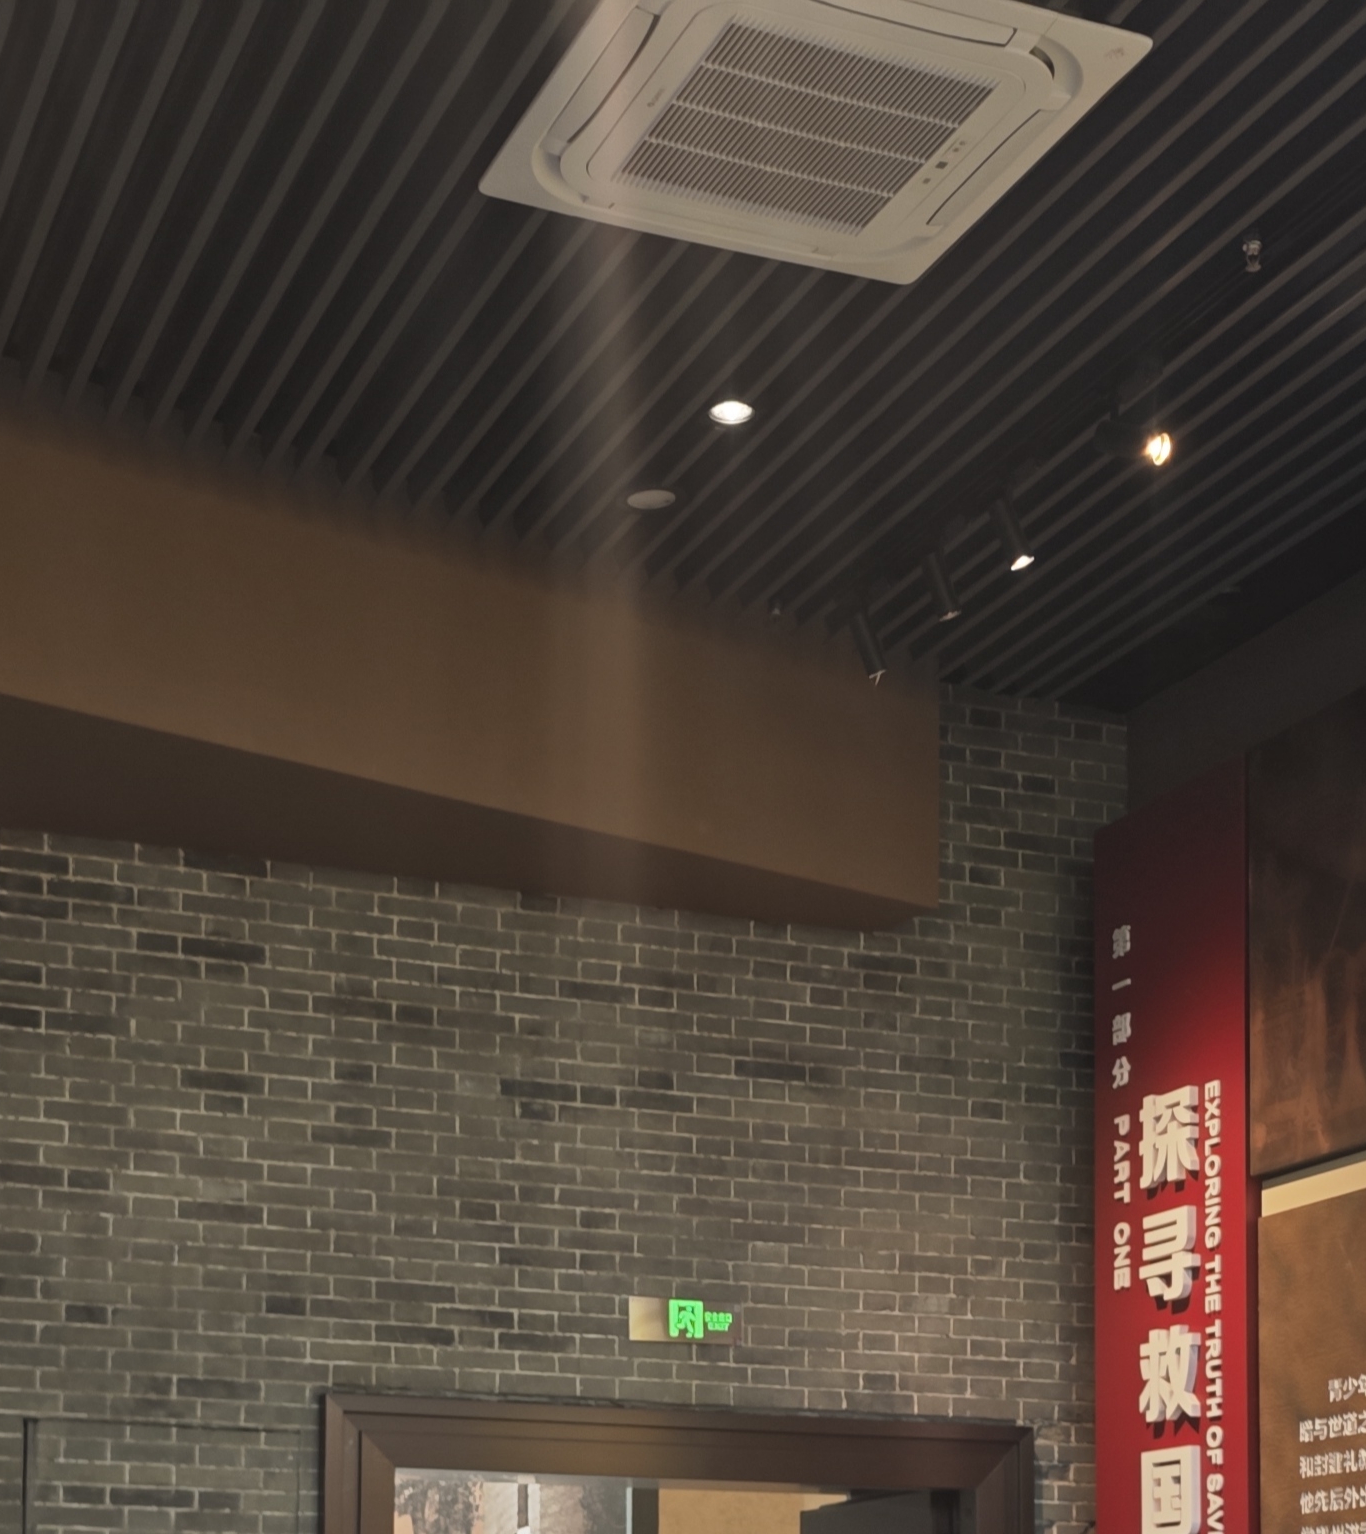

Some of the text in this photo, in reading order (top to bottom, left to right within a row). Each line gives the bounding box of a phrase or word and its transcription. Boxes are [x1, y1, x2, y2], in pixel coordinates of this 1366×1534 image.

[1111, 924, 1132, 1089] 第一部分
[1113, 1114, 1132, 1291] PART ONE
[1204, 1079, 1221, 1250] EXPLORING
[1204, 1254, 1221, 1314] THE
[1204, 1319, 1224, 1418] TRUTH
[1206, 1425, 1224, 1466] OF
